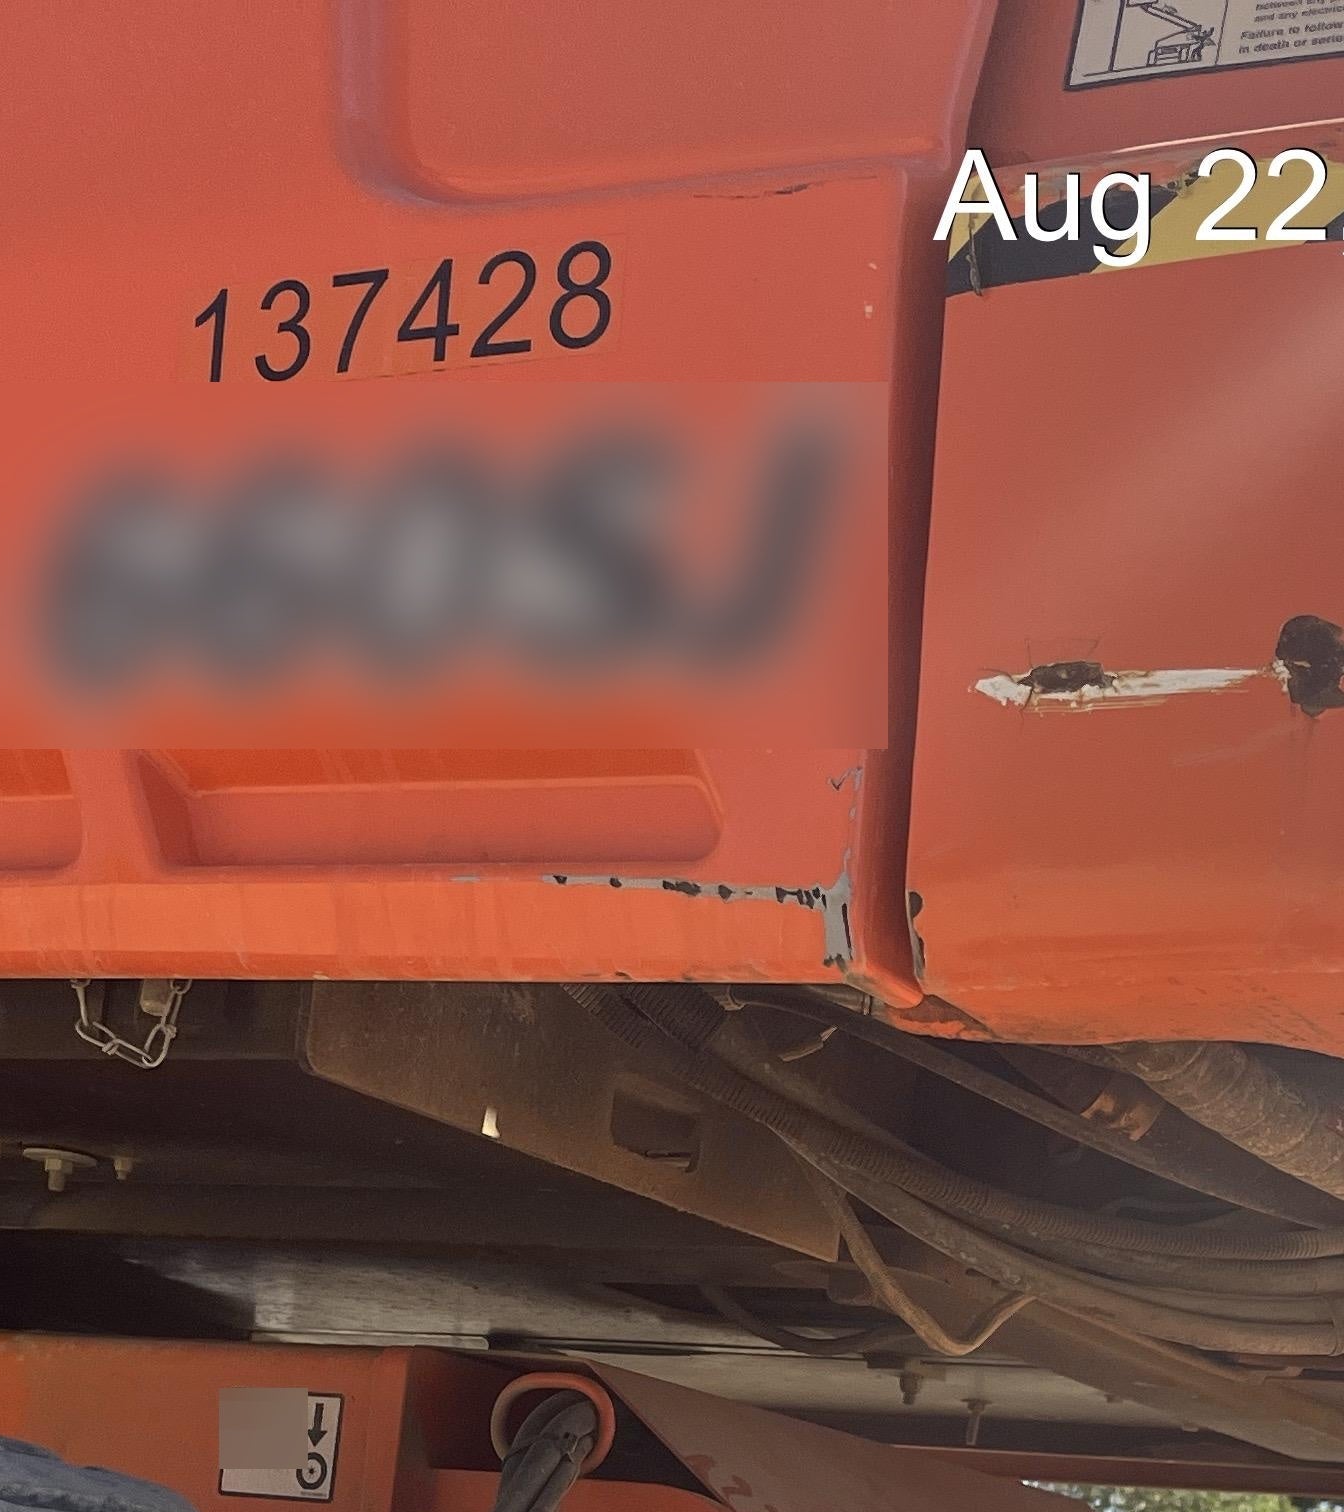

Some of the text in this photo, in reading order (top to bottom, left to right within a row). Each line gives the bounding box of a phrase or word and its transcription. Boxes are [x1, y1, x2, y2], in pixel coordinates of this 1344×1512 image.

[1240, 28, 1284, 39] Failure
[1288, 25, 1301, 34] to
[1304, 20, 1344, 32] follow
[1238, 46, 1250, 54] in
[1254, 39, 1290, 52] death
[1293, 39, 1307, 47] or
[194, 239, 613, 382] 137428
